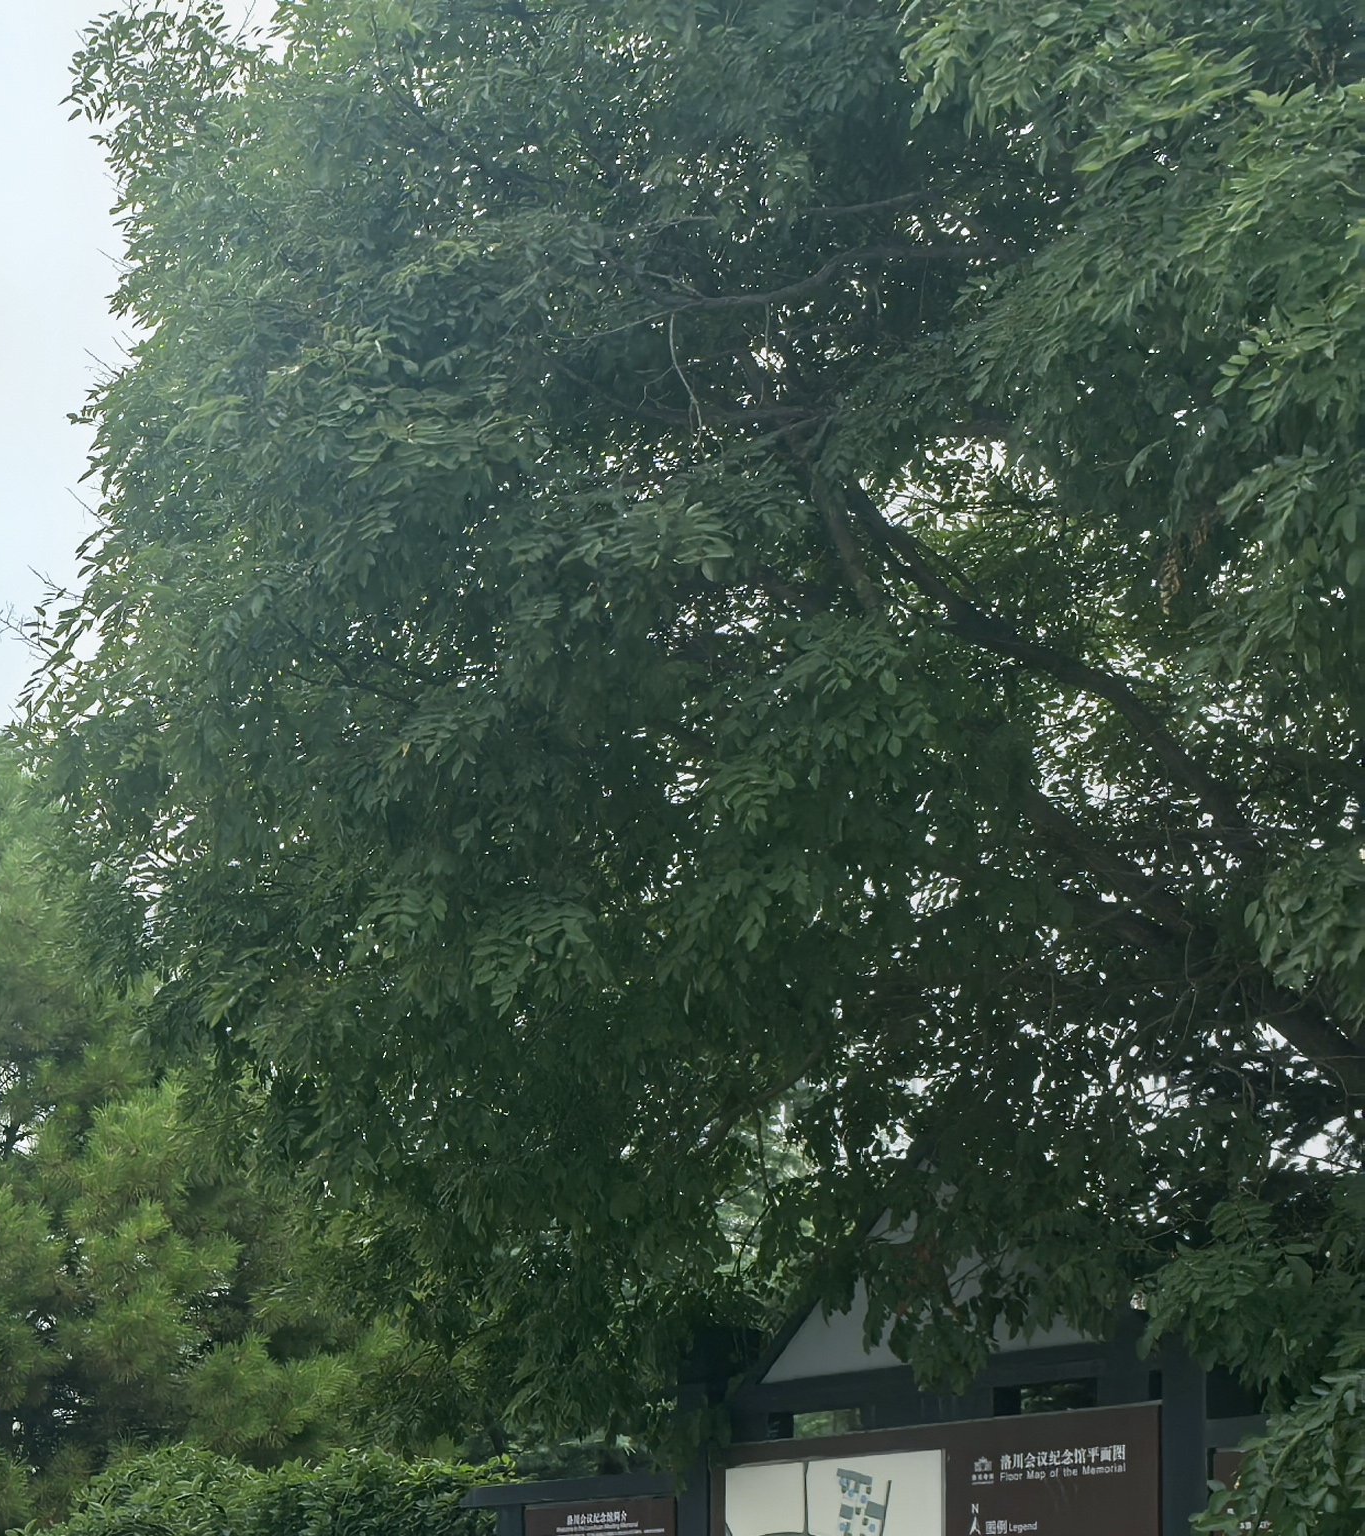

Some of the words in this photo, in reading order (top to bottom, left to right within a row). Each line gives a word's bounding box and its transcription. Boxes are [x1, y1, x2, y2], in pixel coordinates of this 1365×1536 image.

[1000, 1444, 1126, 1470] 洛川会议纪念馆平面图
[1000, 1471, 1023, 1482] Floor
[1026, 1468, 1046, 1480] Map
[1050, 1469, 1059, 1478] of
[1063, 1466, 1078, 1477] the
[1082, 1462, 1127, 1475] Memorial
[971, 1503, 979, 1514] N
[1009, 1521, 1038, 1534] Legend
